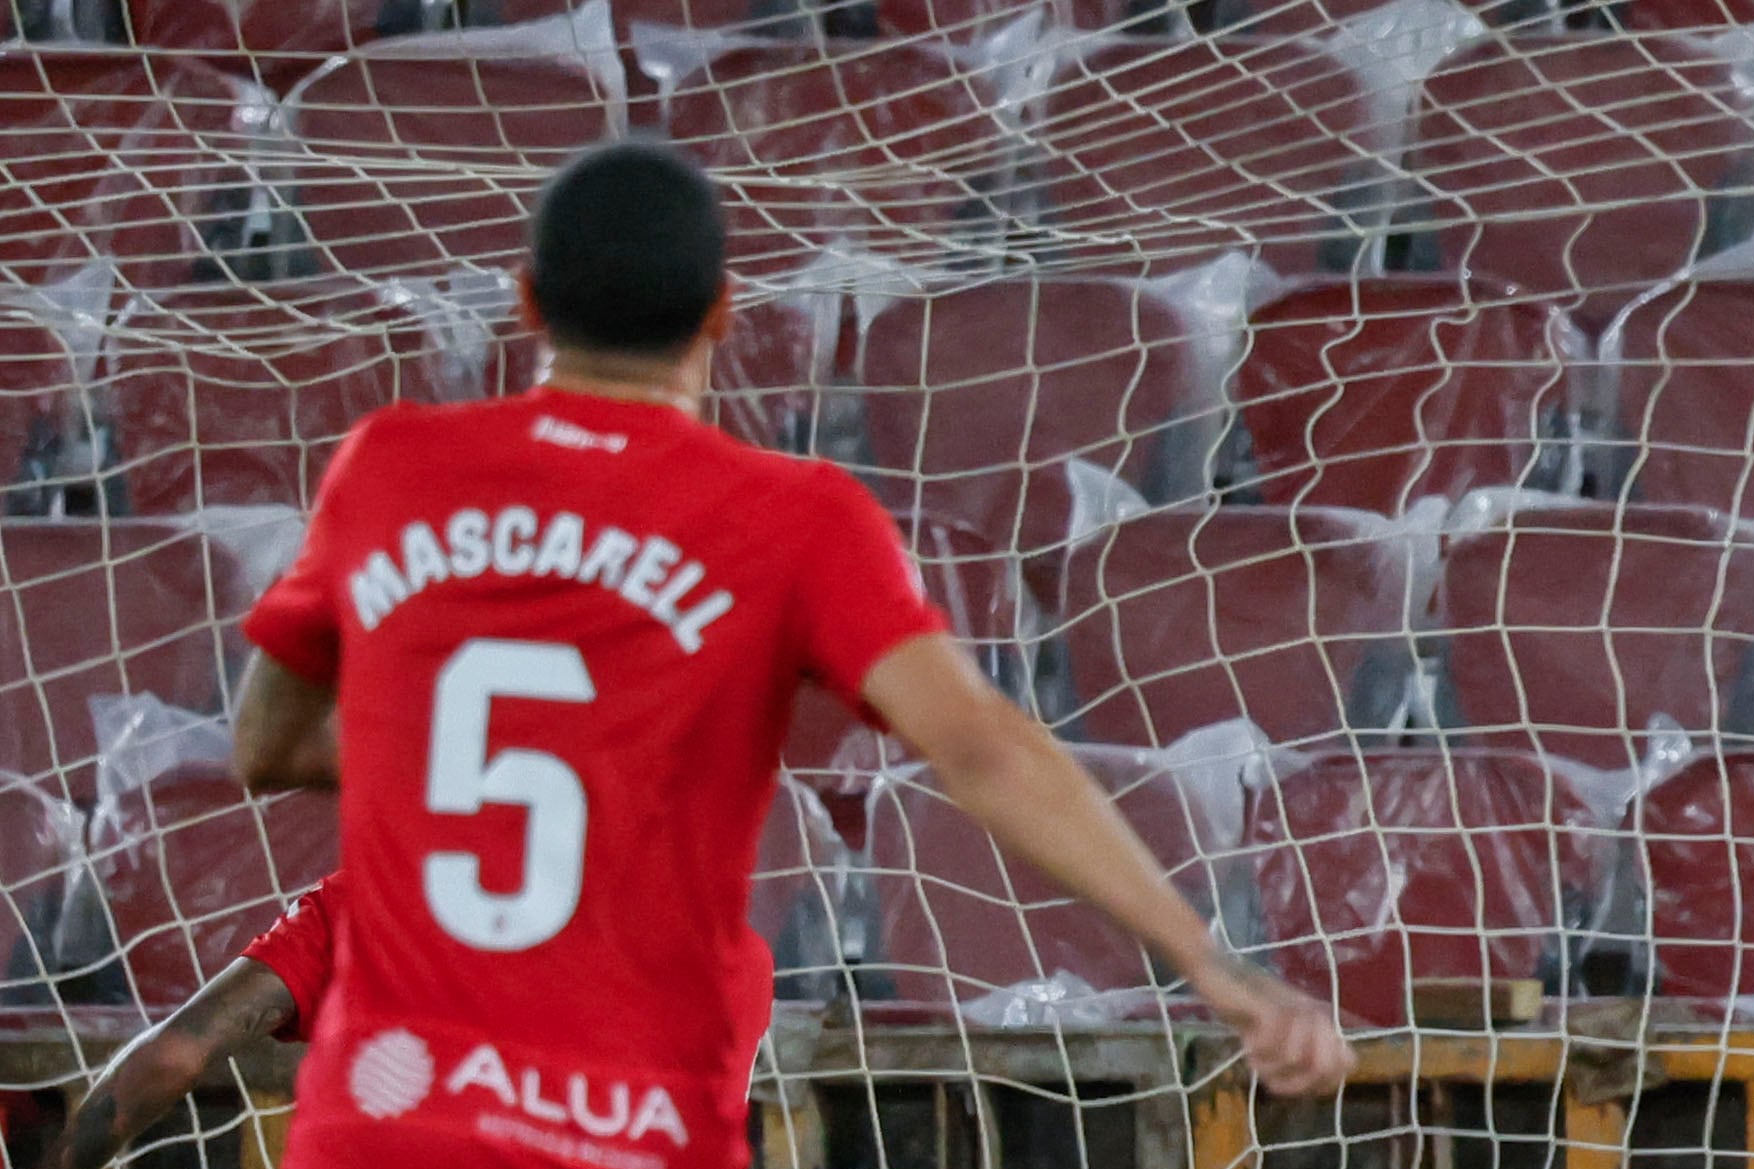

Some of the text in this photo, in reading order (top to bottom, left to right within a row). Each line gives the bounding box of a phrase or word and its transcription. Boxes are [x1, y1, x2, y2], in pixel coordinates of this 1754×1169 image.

[346, 504, 735, 655] MASCARELL
[422, 637, 596, 952] 5
[445, 1044, 688, 1148] ALUA
